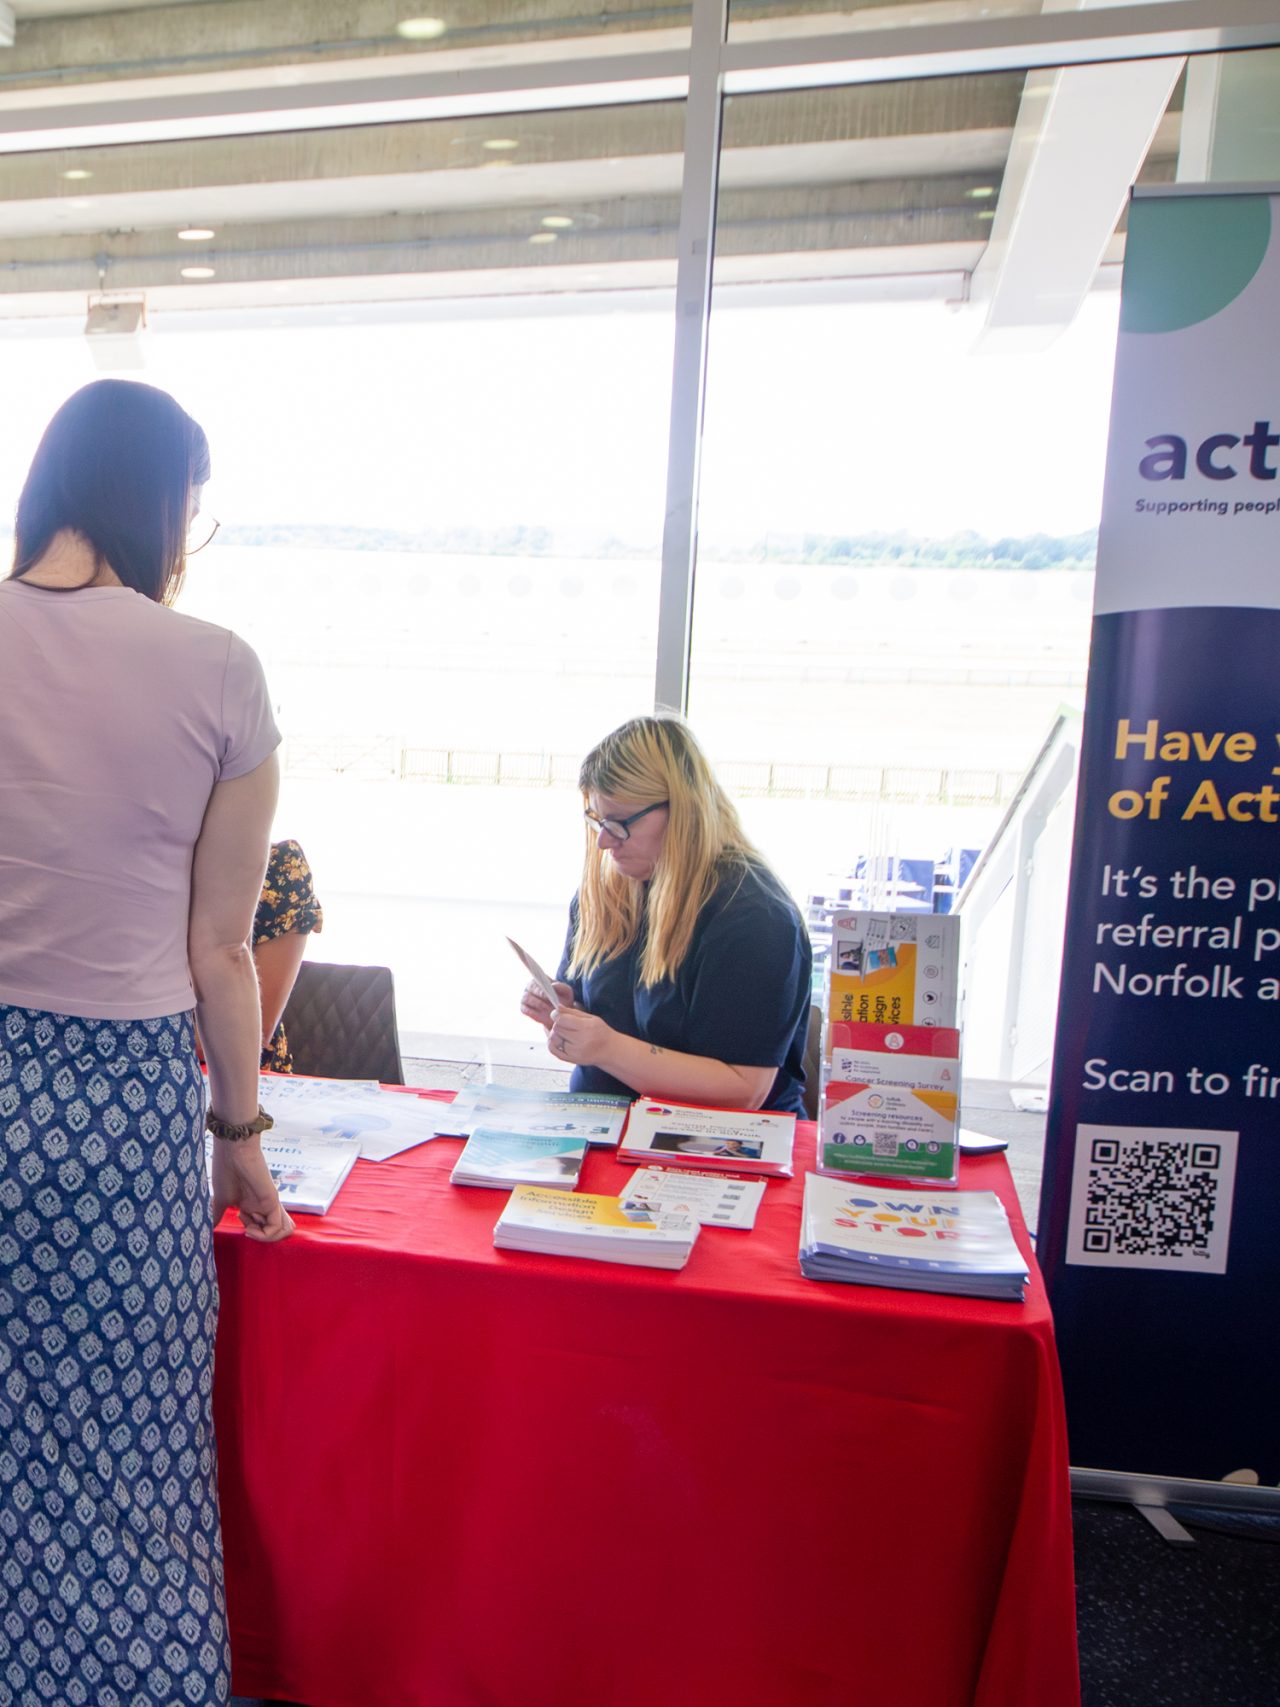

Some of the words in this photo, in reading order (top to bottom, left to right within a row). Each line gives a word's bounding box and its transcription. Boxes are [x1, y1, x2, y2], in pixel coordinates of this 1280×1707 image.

[1135, 498, 1228, 515] Supporting
[1114, 719, 1257, 763] Have
[1108, 776, 1171, 820] of
[1101, 864, 1158, 898] It's
[1169, 866, 1236, 900] the
[1095, 914, 1243, 950] referral
[1092, 963, 1244, 999] Norfolk
[841, 994, 854, 1022] sible
[857, 994, 869, 1023] ation
[845, 1075, 876, 1085] Cancer
[876, 1078, 915, 1089] Screening
[1082, 1058, 1175, 1092] Scan
[1186, 1067, 1230, 1095] to
[851, 1109, 886, 1119] Screening
[847, 1198, 960, 1215] OWN
